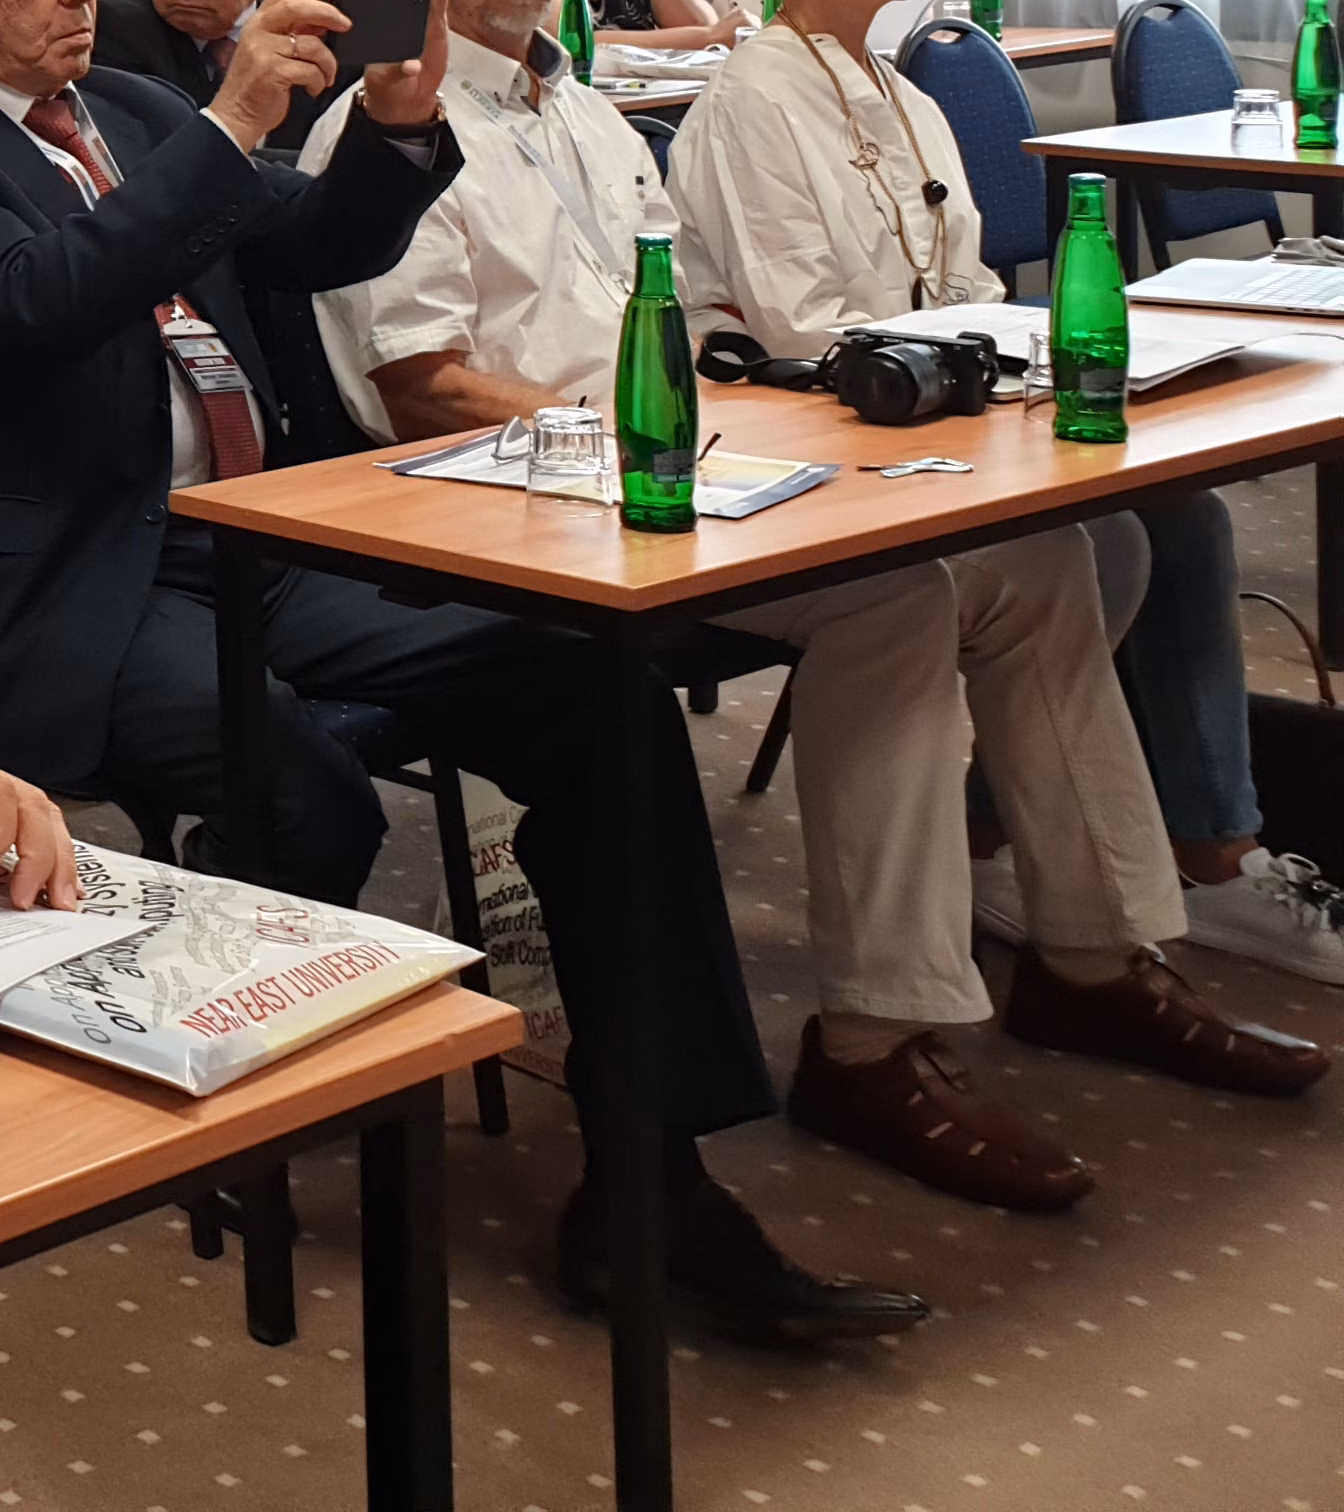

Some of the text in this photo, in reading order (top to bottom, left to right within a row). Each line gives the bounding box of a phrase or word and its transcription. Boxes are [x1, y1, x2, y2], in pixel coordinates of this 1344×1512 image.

[180, 940, 402, 1039] NEAR EAST UNIVERSITY
